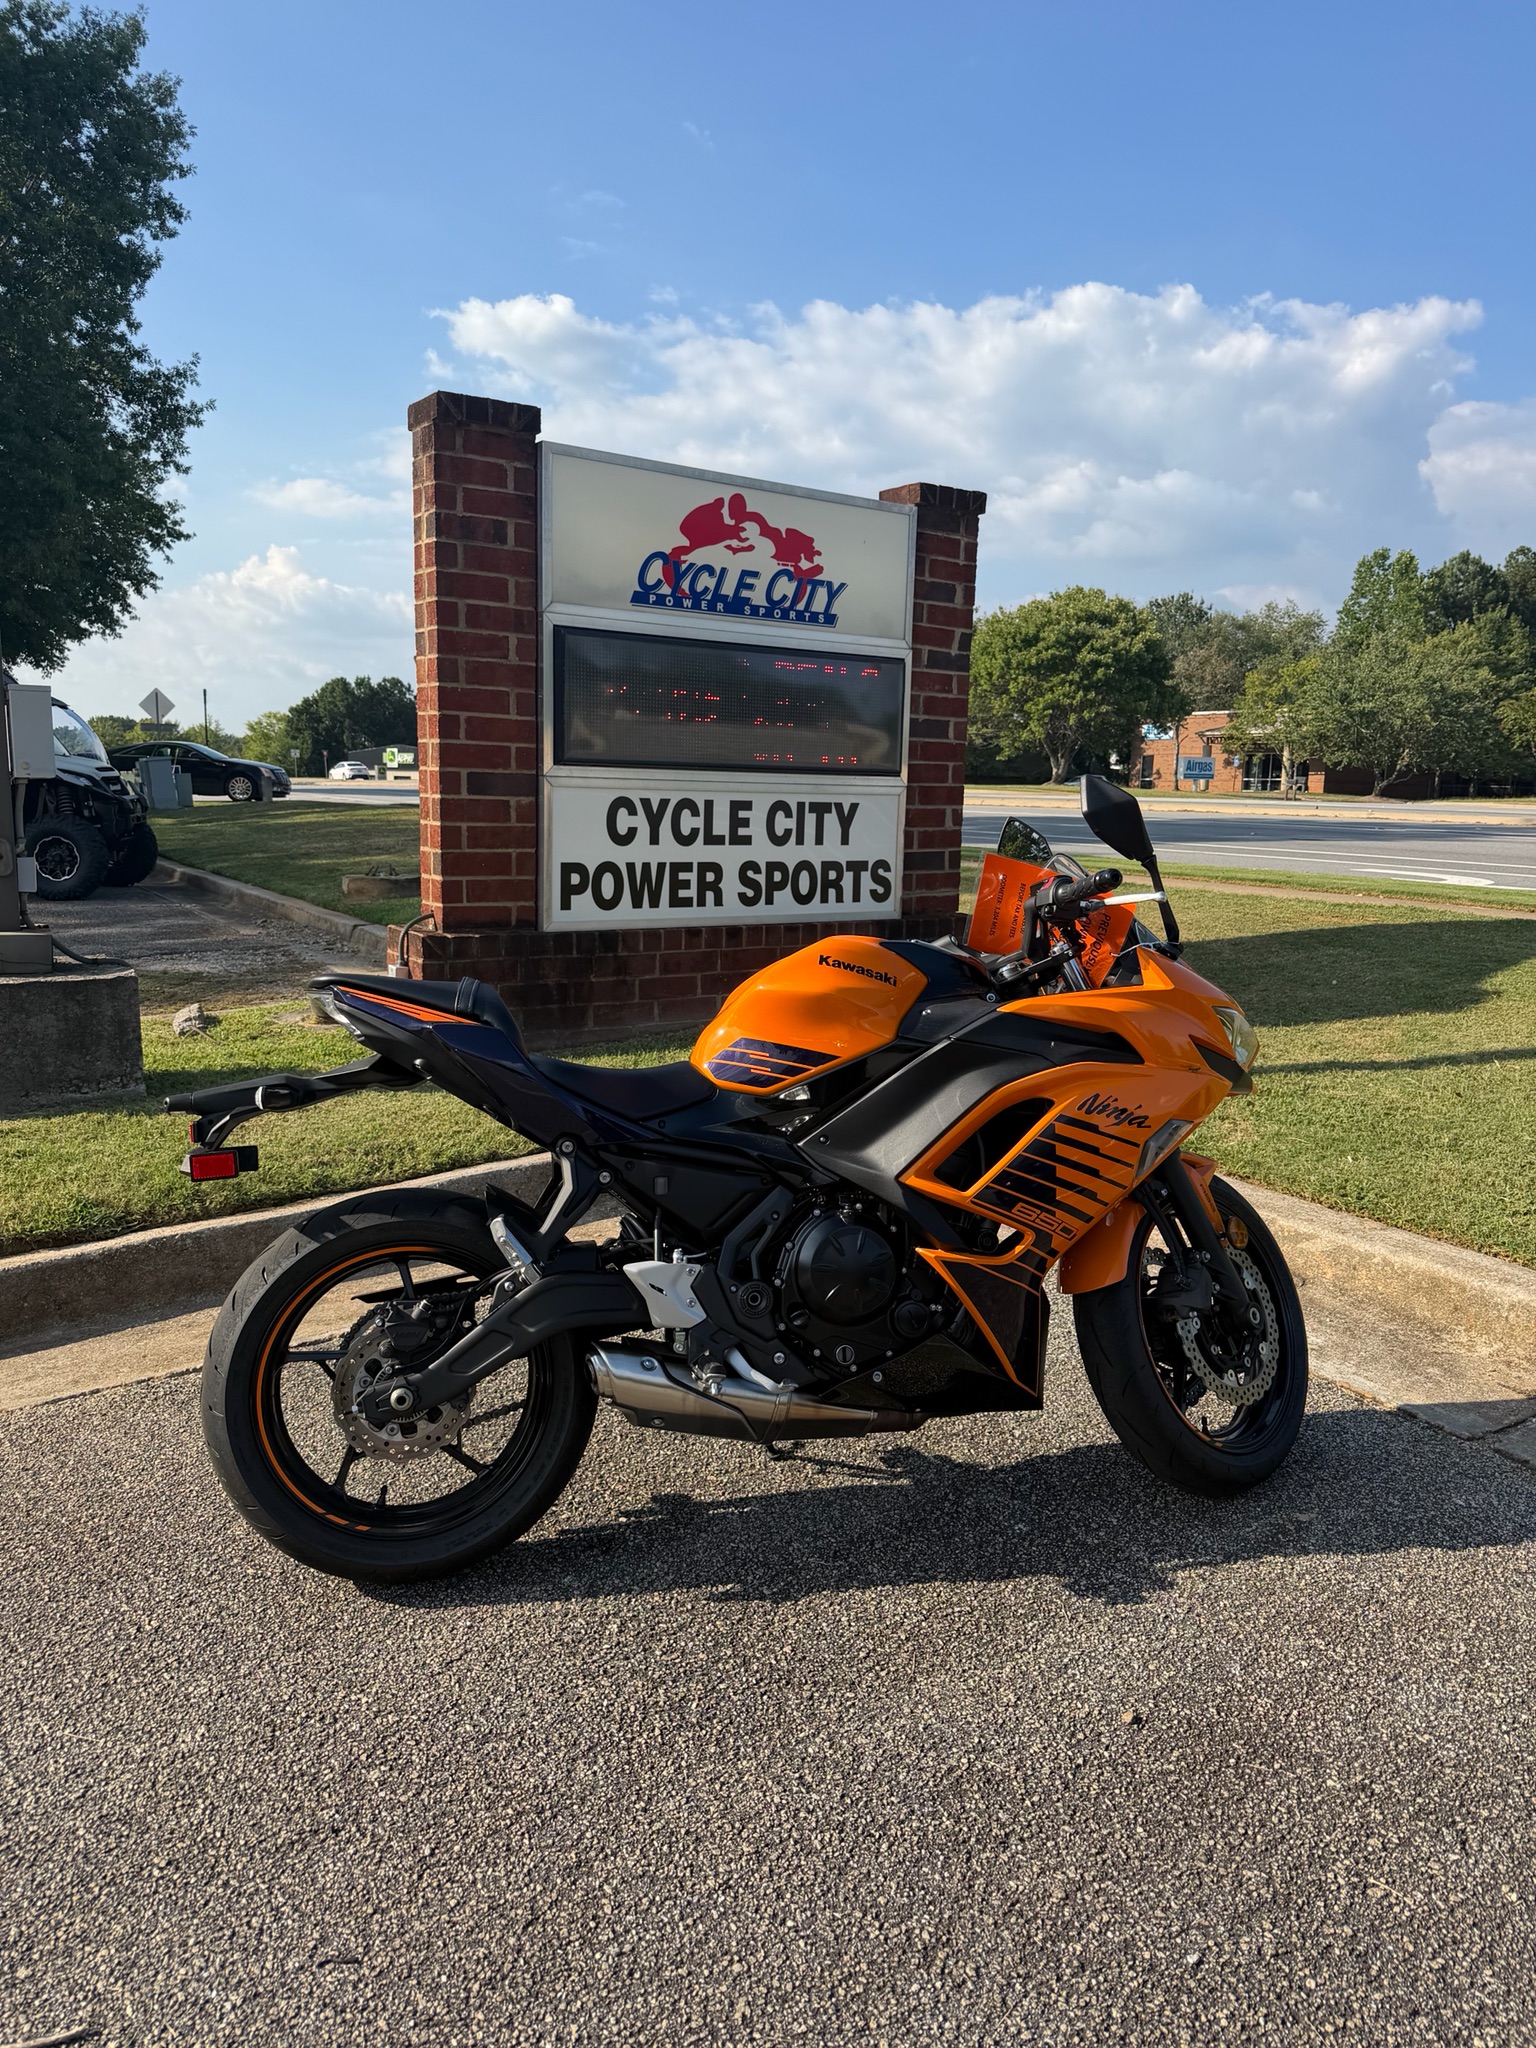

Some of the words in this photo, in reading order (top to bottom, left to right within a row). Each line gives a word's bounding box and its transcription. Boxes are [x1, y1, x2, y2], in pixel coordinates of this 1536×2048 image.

[637, 551, 761, 602] CYCLE
[764, 568, 848, 614] CITY
[649, 594, 725, 612] POWER
[744, 604, 826, 623] SPORTS
[1186, 759, 1213, 773] Airgas
[606, 795, 753, 847] CYCLE
[765, 800, 860, 848] CITY
[560, 860, 724, 911] POWER
[737, 859, 892, 908] SPORTS
[989, 920, 998, 937] MILES
[818, 954, 898, 987] Kawasaki
[1075, 1093, 1152, 1129] Ninja
[1010, 1201, 1080, 1242] 650
